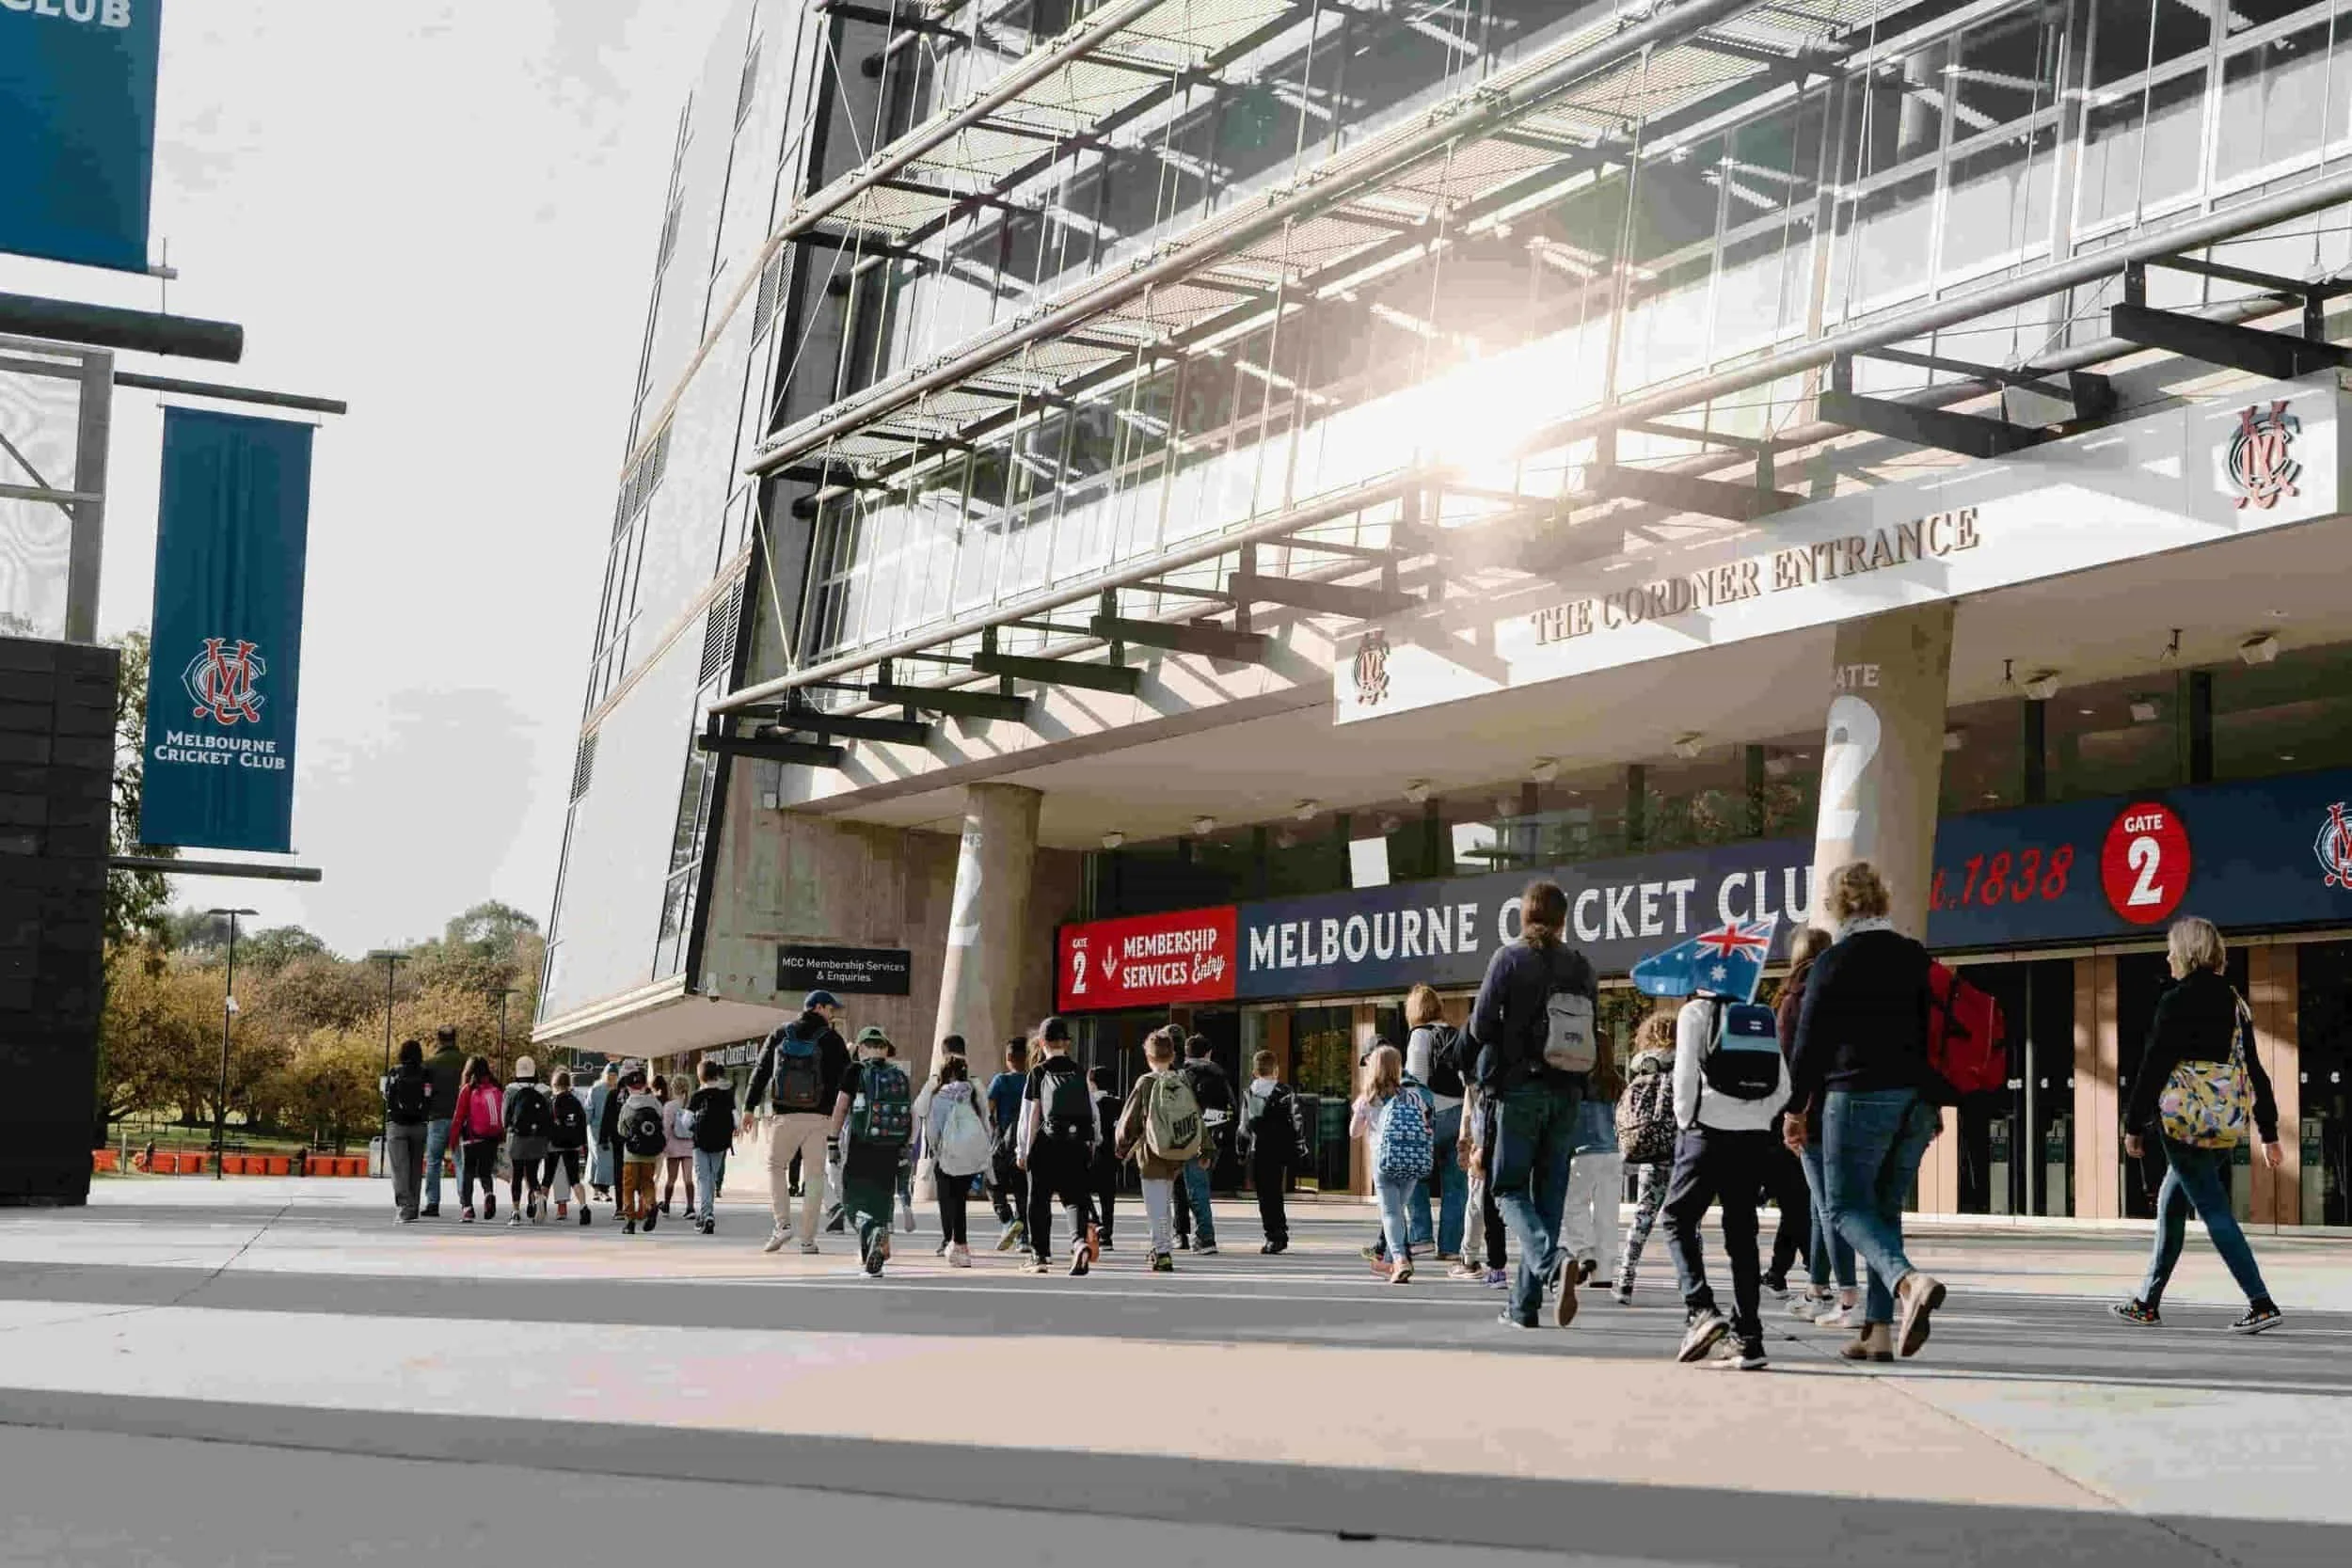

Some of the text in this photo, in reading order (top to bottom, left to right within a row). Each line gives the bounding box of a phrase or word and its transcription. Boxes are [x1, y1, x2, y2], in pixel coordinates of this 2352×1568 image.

[1531, 507, 1980, 645] THE CORDNER ENTRANCE
[1833, 662, 1881, 689] ATE
[167, 731, 276, 752] MELBOURNE
[153, 745, 286, 769] CRICKET CLUB
[2124, 814, 2163, 832] GATE
[2127, 835, 2163, 906] 2
[1248, 865, 1815, 972] MELBOURNE CCKET CLU
[1123, 927, 1217, 960] MEMBERSHIP
[782, 957, 906, 972] MCC Membership Services
[827, 971, 872, 984] Enquiries
[1072, 951, 1087, 994] 2
[1122, 953, 1225, 989] SERVICES Entry
